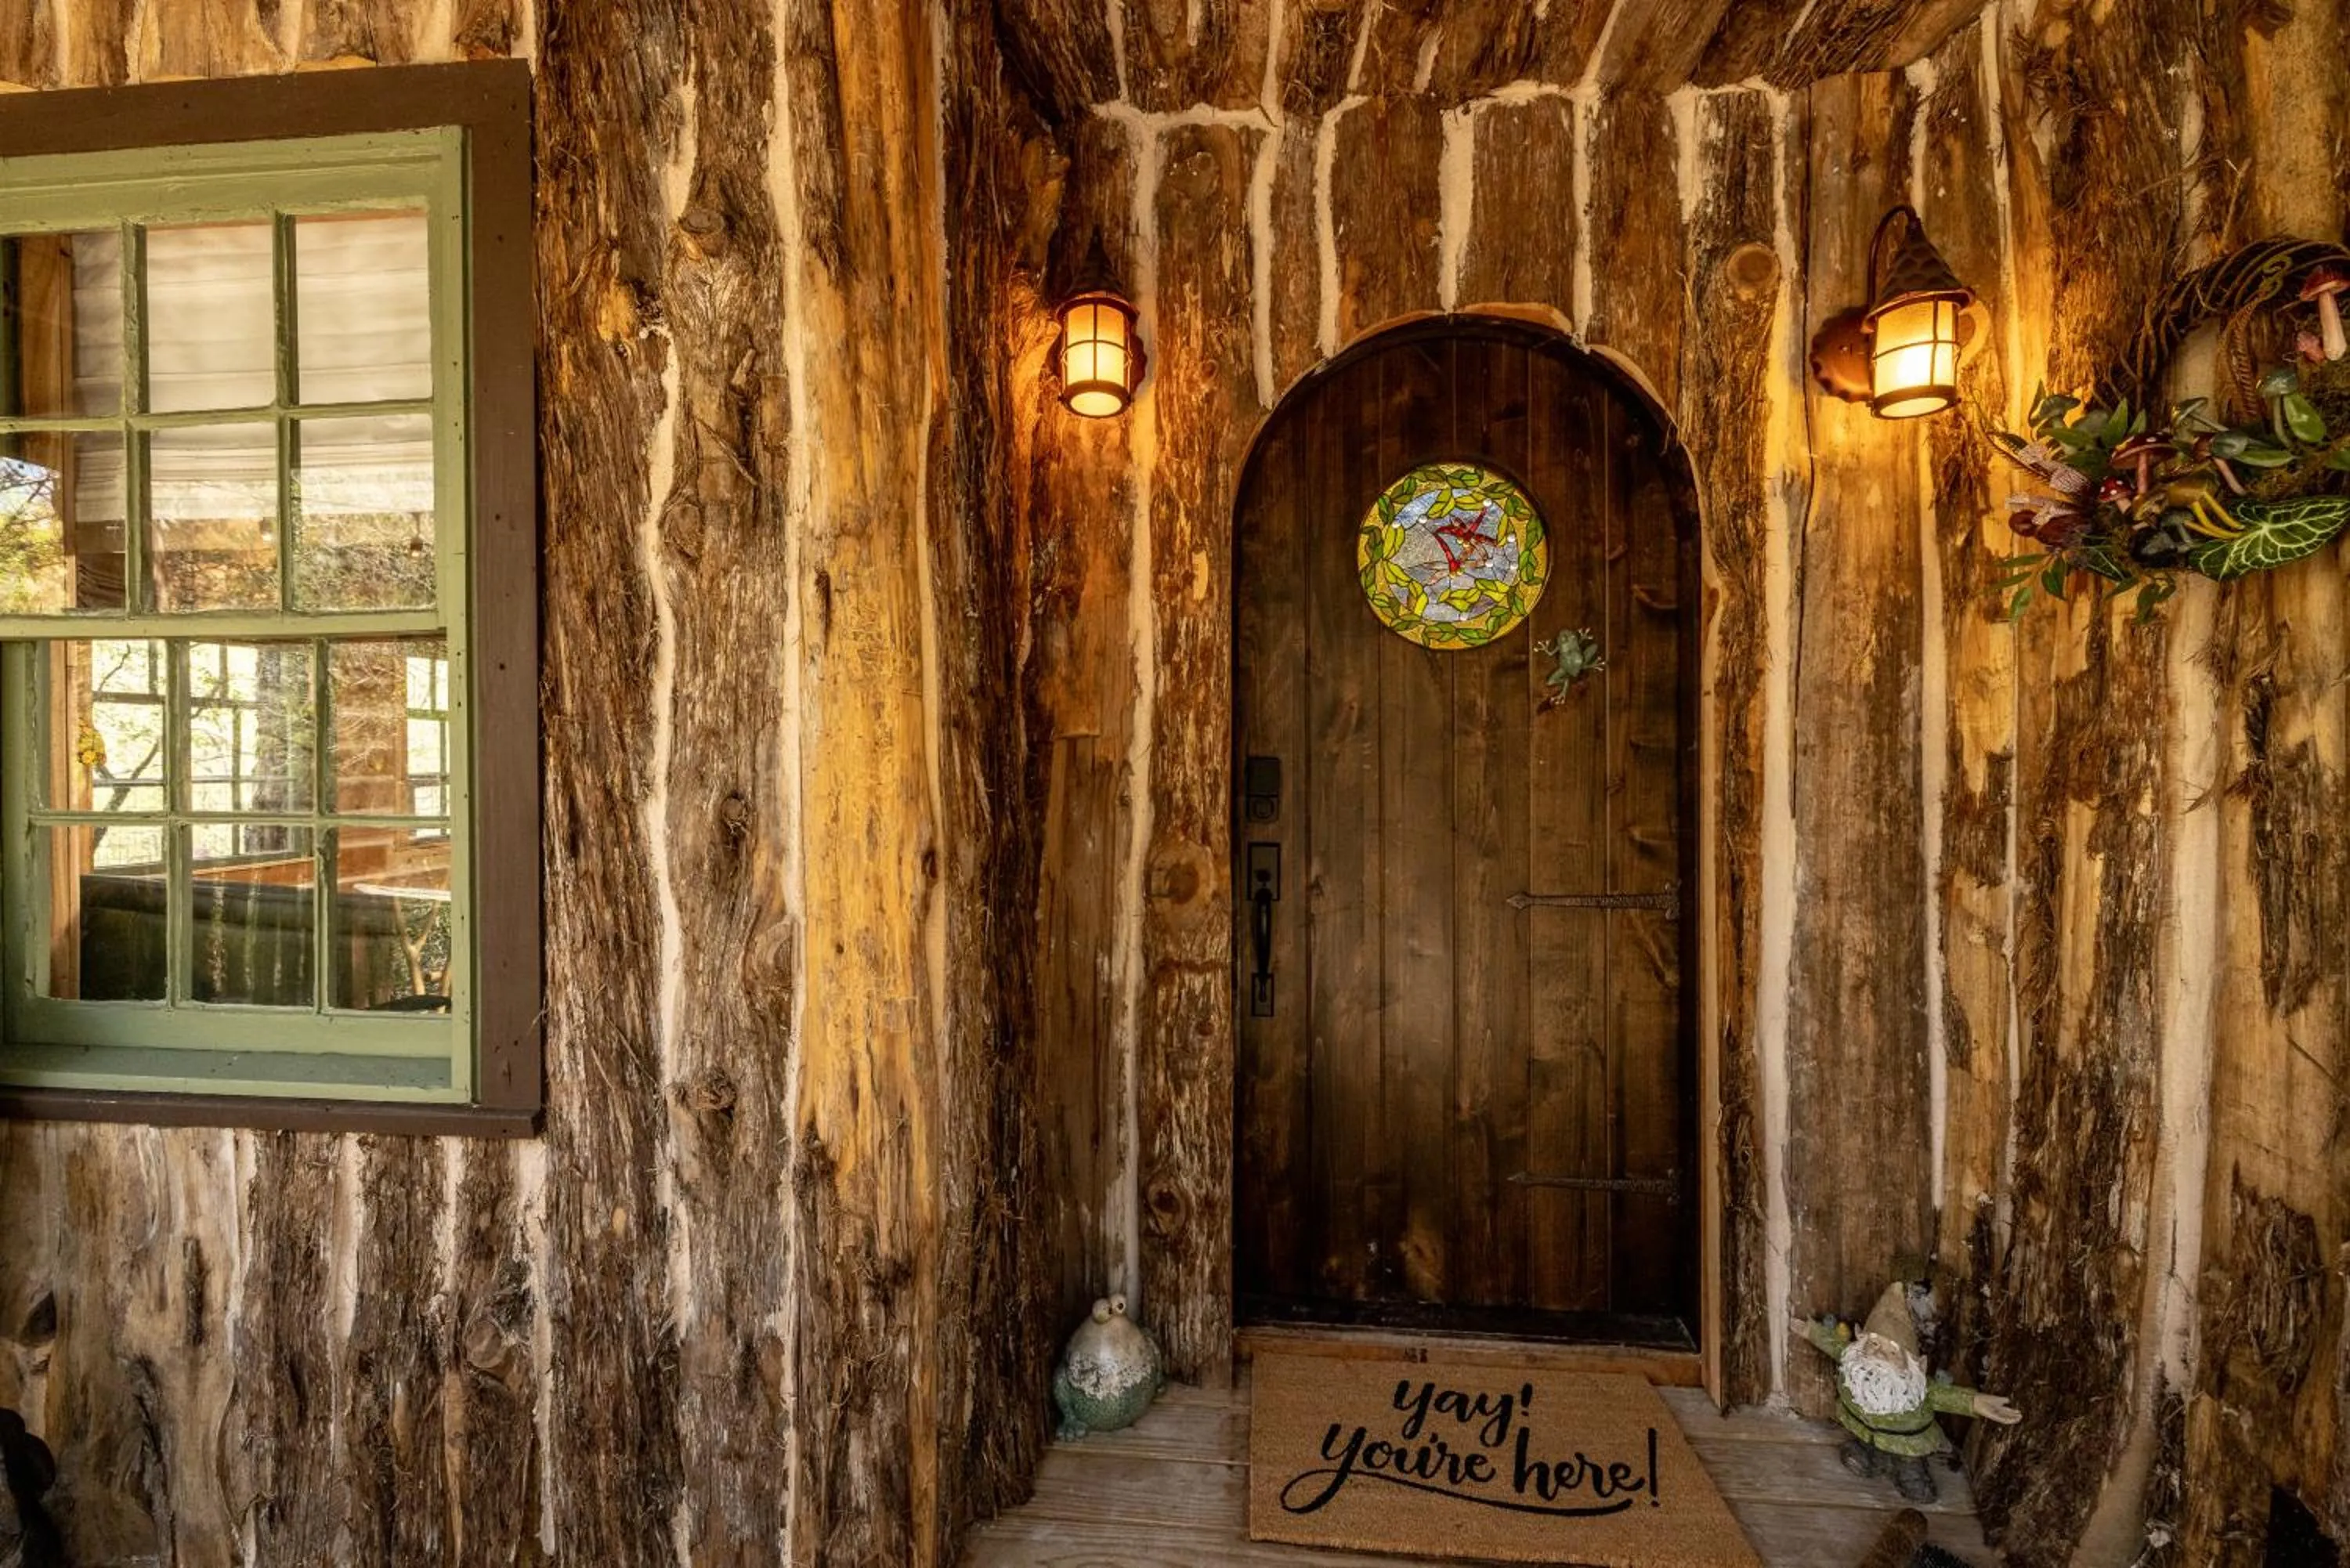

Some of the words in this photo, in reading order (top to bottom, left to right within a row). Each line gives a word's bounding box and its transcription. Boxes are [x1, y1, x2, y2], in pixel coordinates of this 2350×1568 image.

[1392, 1379, 1534, 1448] yay!
[1280, 1422, 1497, 1513] you're
[1512, 1426, 1661, 1508] here!
